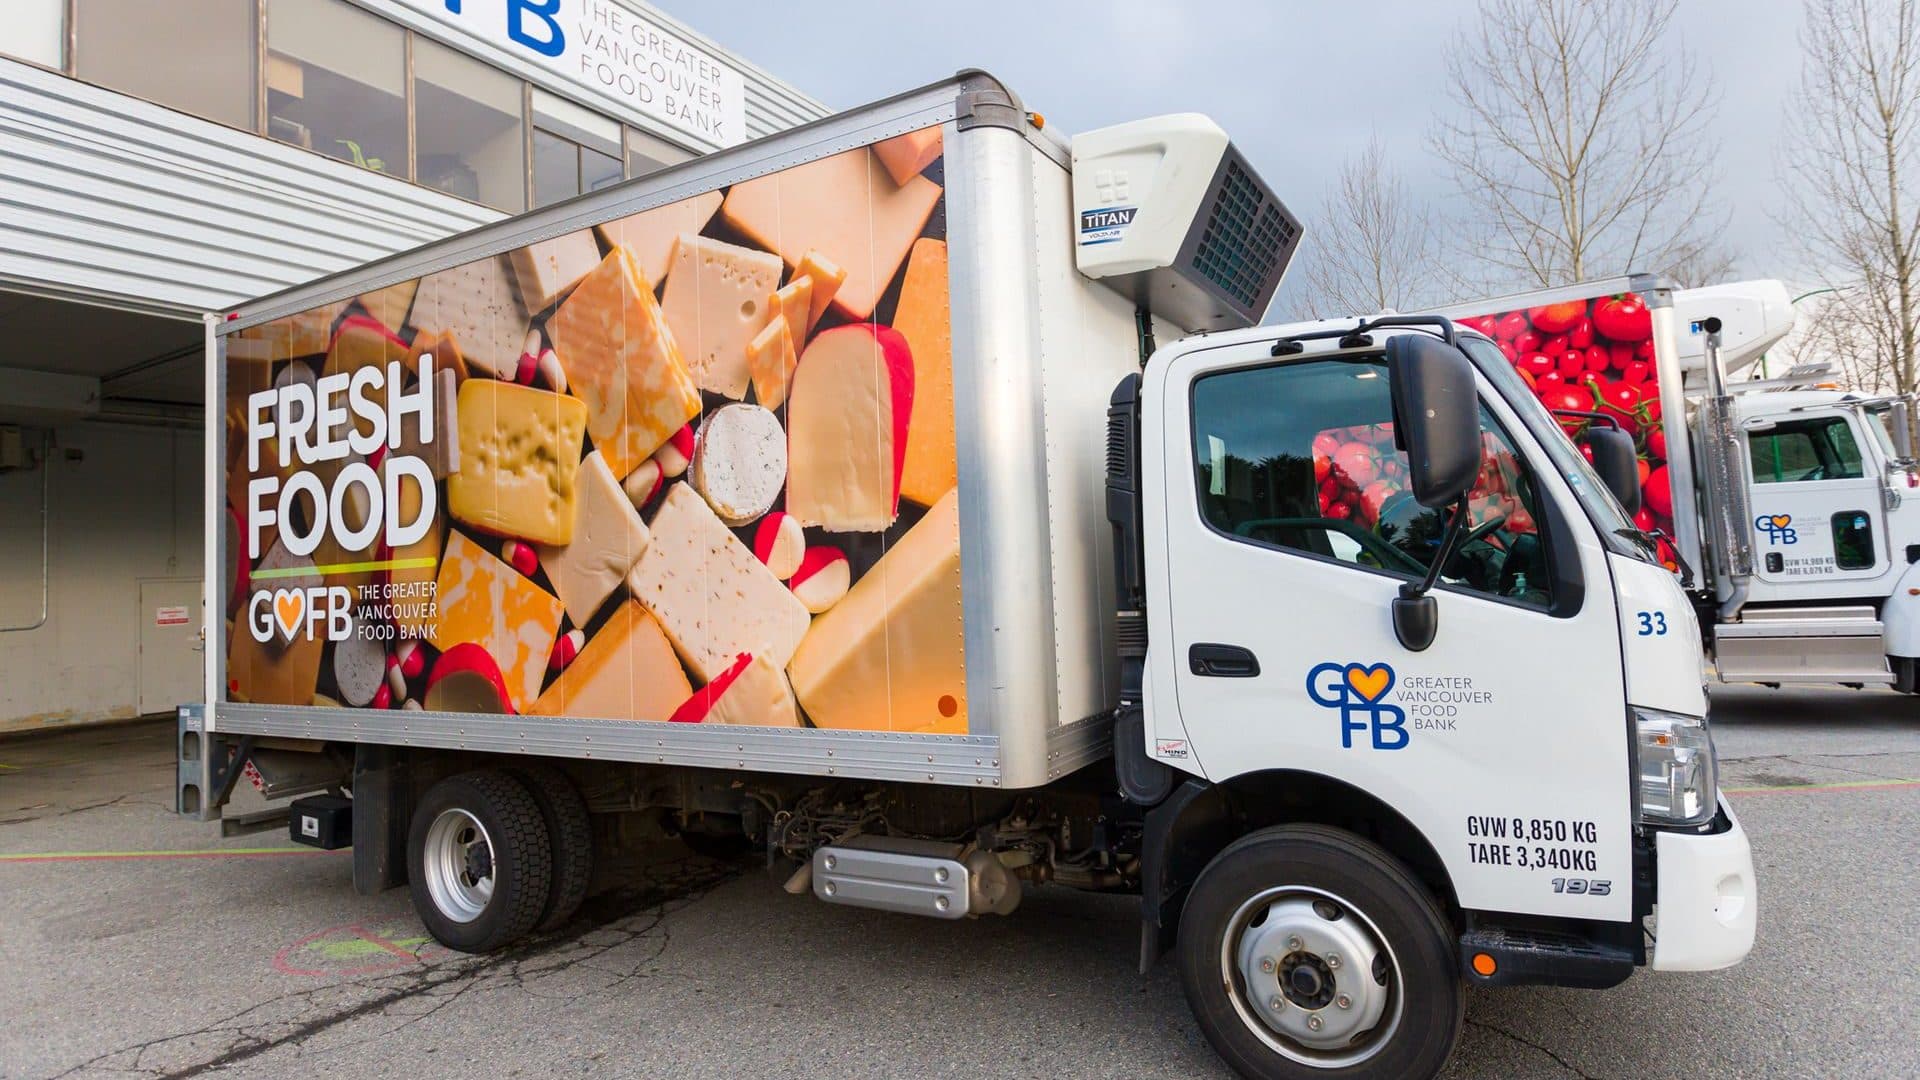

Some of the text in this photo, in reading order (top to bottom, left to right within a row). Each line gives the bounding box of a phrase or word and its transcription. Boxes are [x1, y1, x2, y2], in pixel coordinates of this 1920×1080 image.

[581, 0, 721, 87] THE GREATER
[578, 23, 722, 112] VANCOUVER
[581, 53, 724, 139] FOOD BANK
[249, 353, 434, 473] FRESH
[249, 455, 437, 560] FOOD
[1785, 559, 1800, 567] GVW
[1825, 556, 1834, 564] KG
[1785, 567, 1801, 576] TARE
[1825, 566, 1833, 574] KG
[358, 581, 437, 600] THE GREATER
[357, 602, 437, 620] VANCOUVER
[358, 623, 438, 640] FOOD BANK
[1637, 611, 1667, 636] 33
[1403, 677, 1472, 689] GREATER
[1396, 691, 1493, 703] VANCOUVER
[1411, 705, 1458, 717] FOOD
[1414, 719, 1457, 730] BANK
[1467, 816, 1597, 843] GVW 8,850 KG
[1468, 843, 1597, 872] TARE 3,340KG
[1552, 878, 1612, 896] 195
